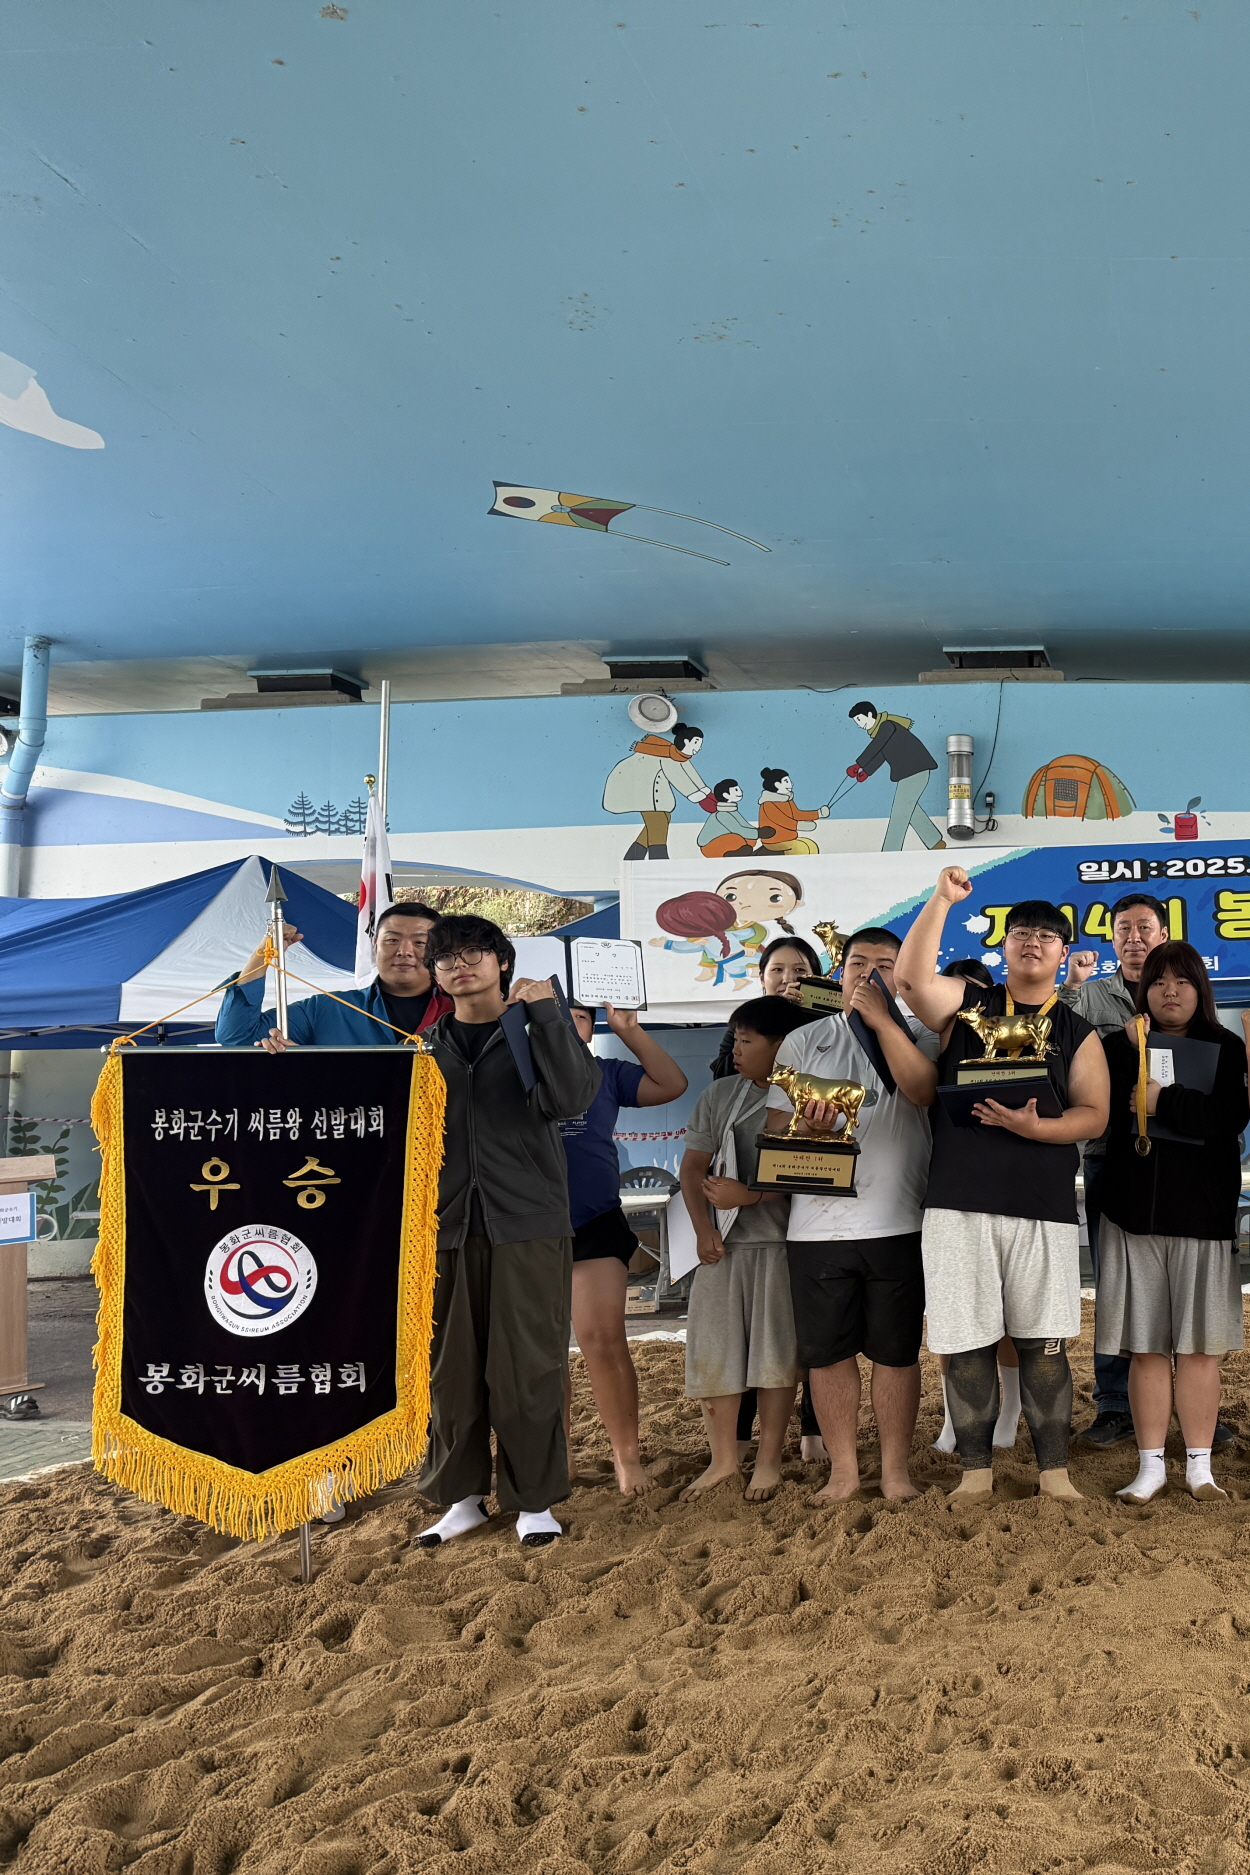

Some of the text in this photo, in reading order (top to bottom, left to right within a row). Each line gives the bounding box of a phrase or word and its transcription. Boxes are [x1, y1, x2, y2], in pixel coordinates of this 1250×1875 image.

[151, 1105, 384, 1142] 봉화군수기 씨름왕 선발대회
[219, 1227, 303, 1254] 봉화군씨름협회
[138, 1361, 367, 1397] 봉화군씨름협회
